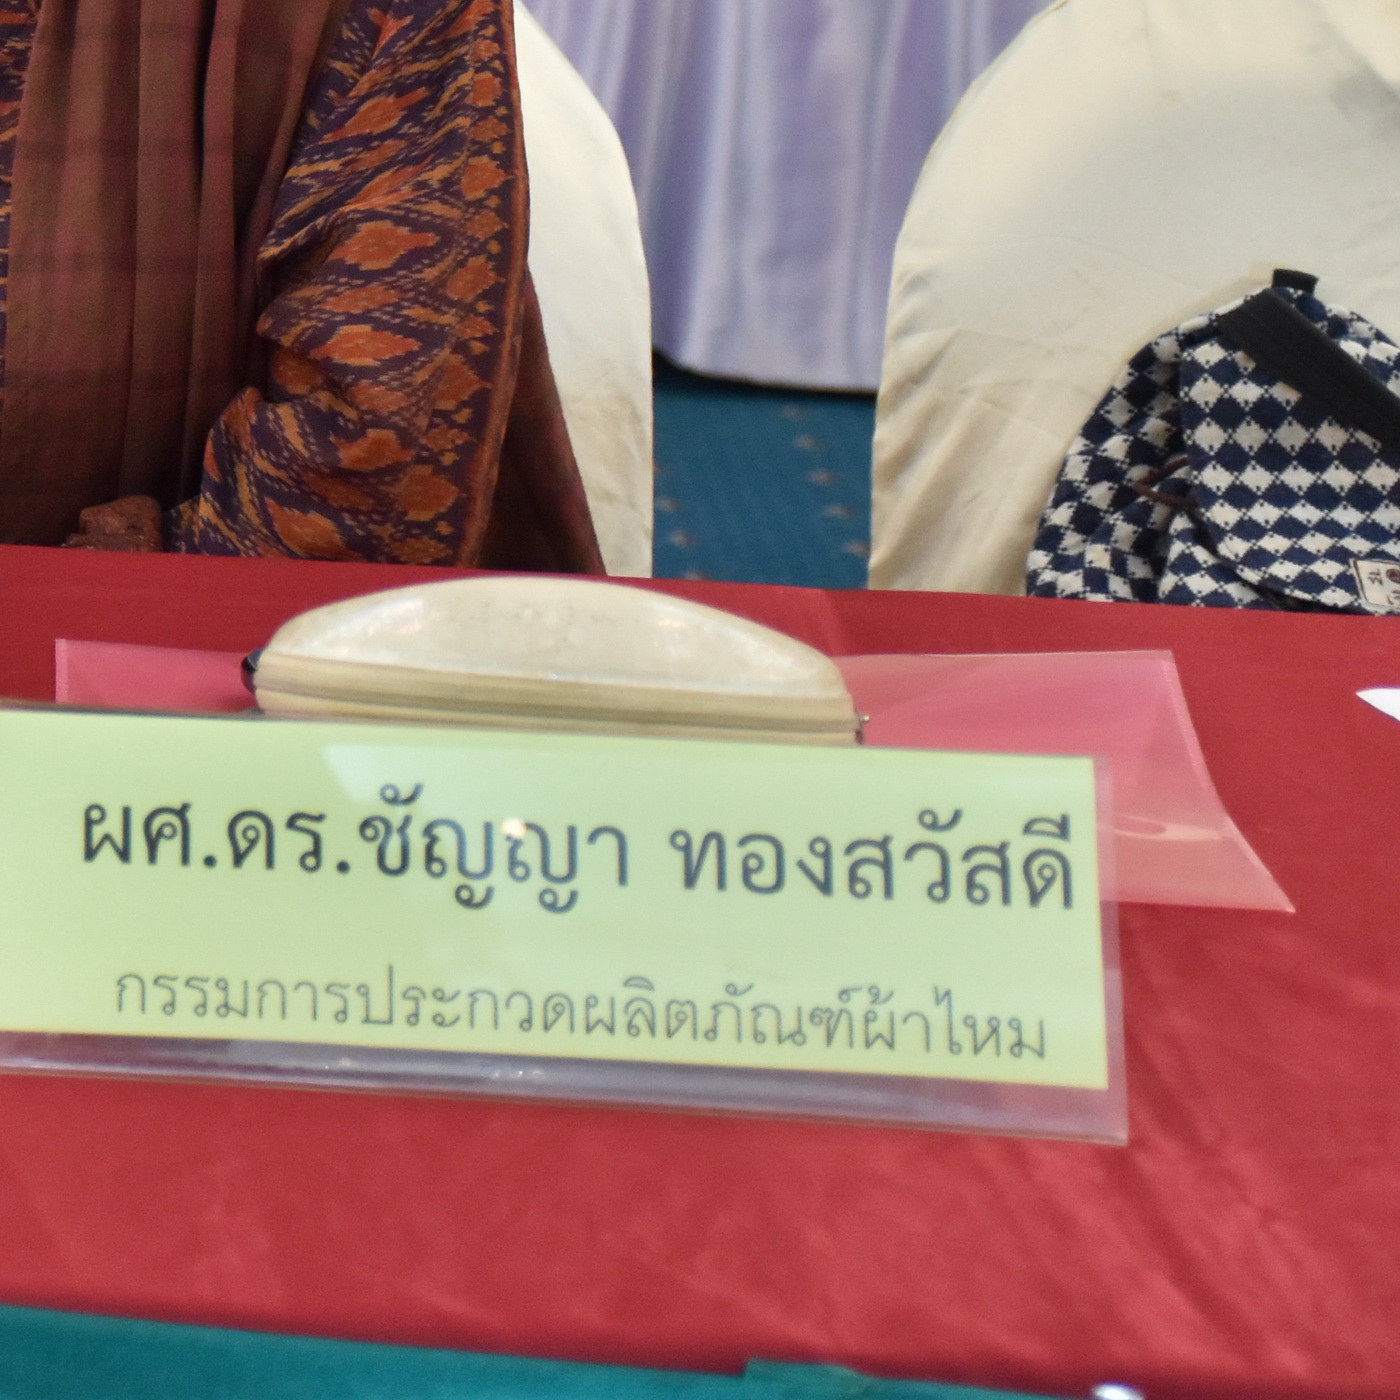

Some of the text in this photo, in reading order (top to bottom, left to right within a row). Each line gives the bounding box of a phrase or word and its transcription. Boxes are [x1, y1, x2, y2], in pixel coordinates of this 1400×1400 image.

[82, 783, 1073, 914] ผศ.ดร.ชัญญา ทองสวัสดี
[115, 964, 1046, 1059] กรรมการประกวดผลิตภัณฑ์ผ้าไหม
